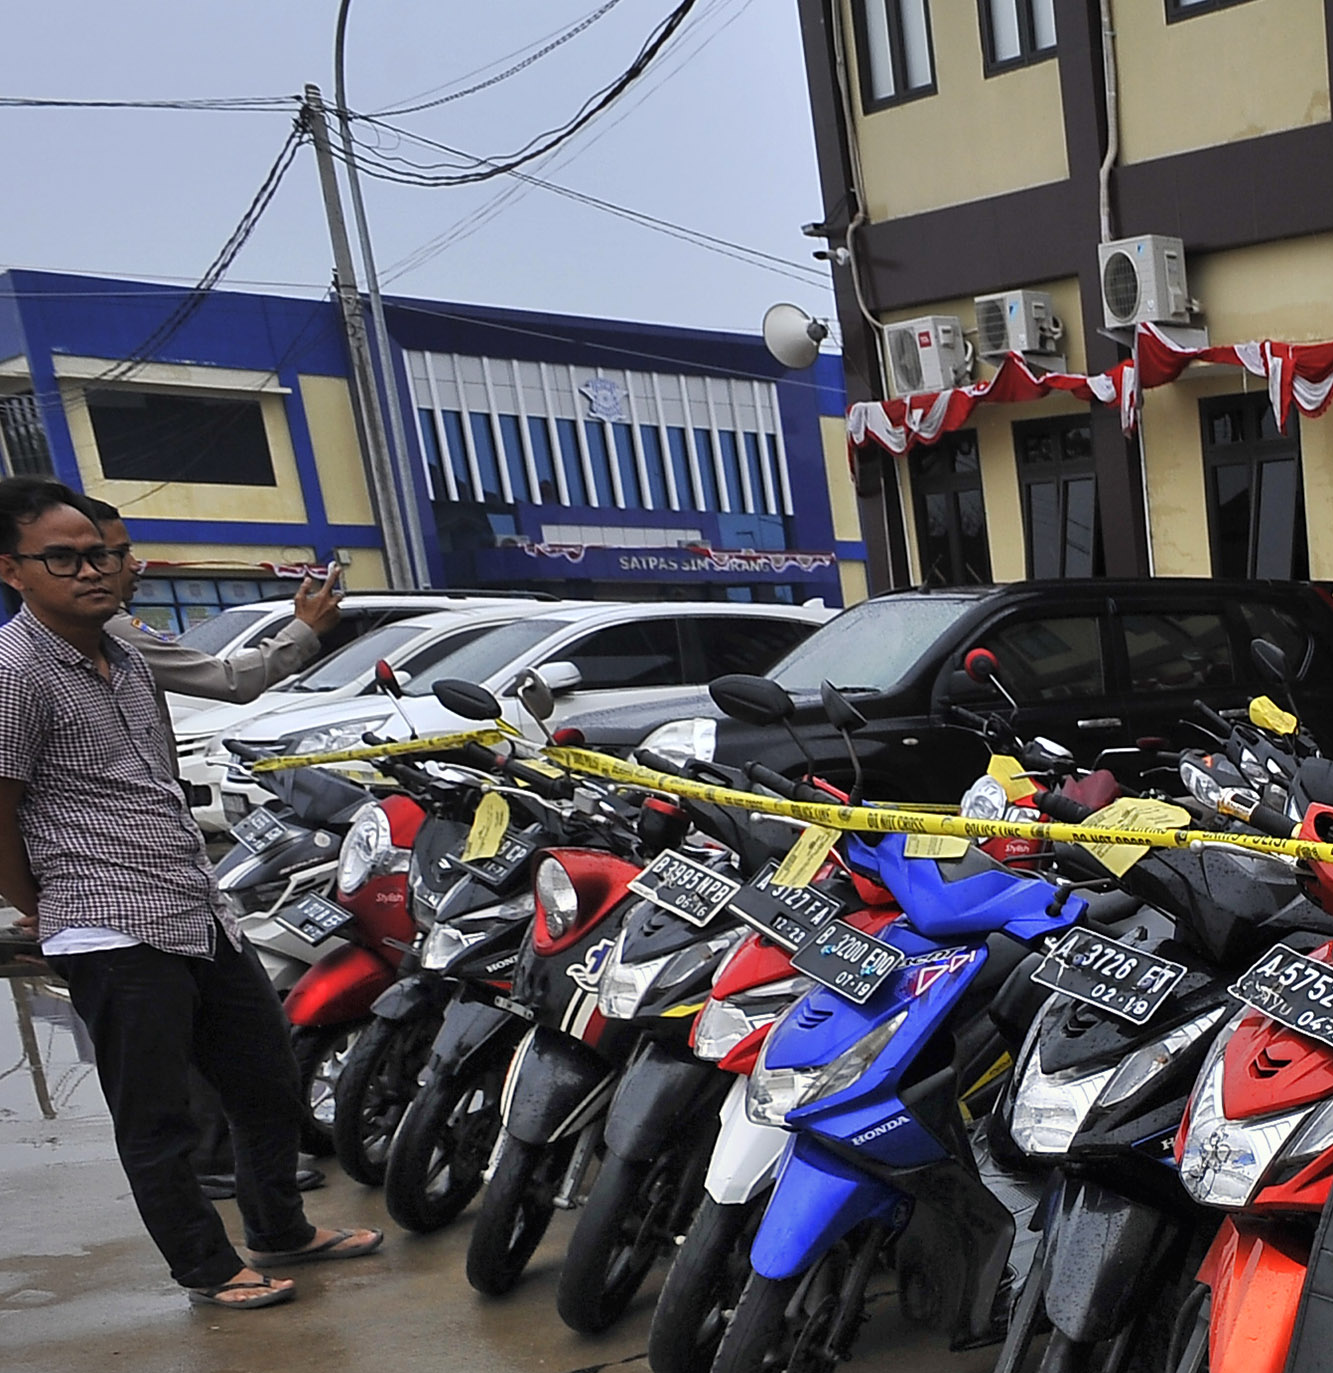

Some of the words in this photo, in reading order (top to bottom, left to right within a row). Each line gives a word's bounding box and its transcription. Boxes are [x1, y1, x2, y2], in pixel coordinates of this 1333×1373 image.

[619, 556, 678, 570] SATPAS
[681, 557, 709, 571] SIM
[652, 856, 665, 874] B
[664, 860, 701, 888] 3995
[756, 872, 774, 892] A
[805, 901, 830, 926] FA
[816, 926, 836, 946] B
[831, 934, 863, 965] 3200
[1055, 934, 1079, 958] A
[1082, 943, 1138, 979] 3726
[485, 954, 519, 973] HON
[1257, 954, 1284, 977] A
[851, 1115, 911, 1146] HONDA
